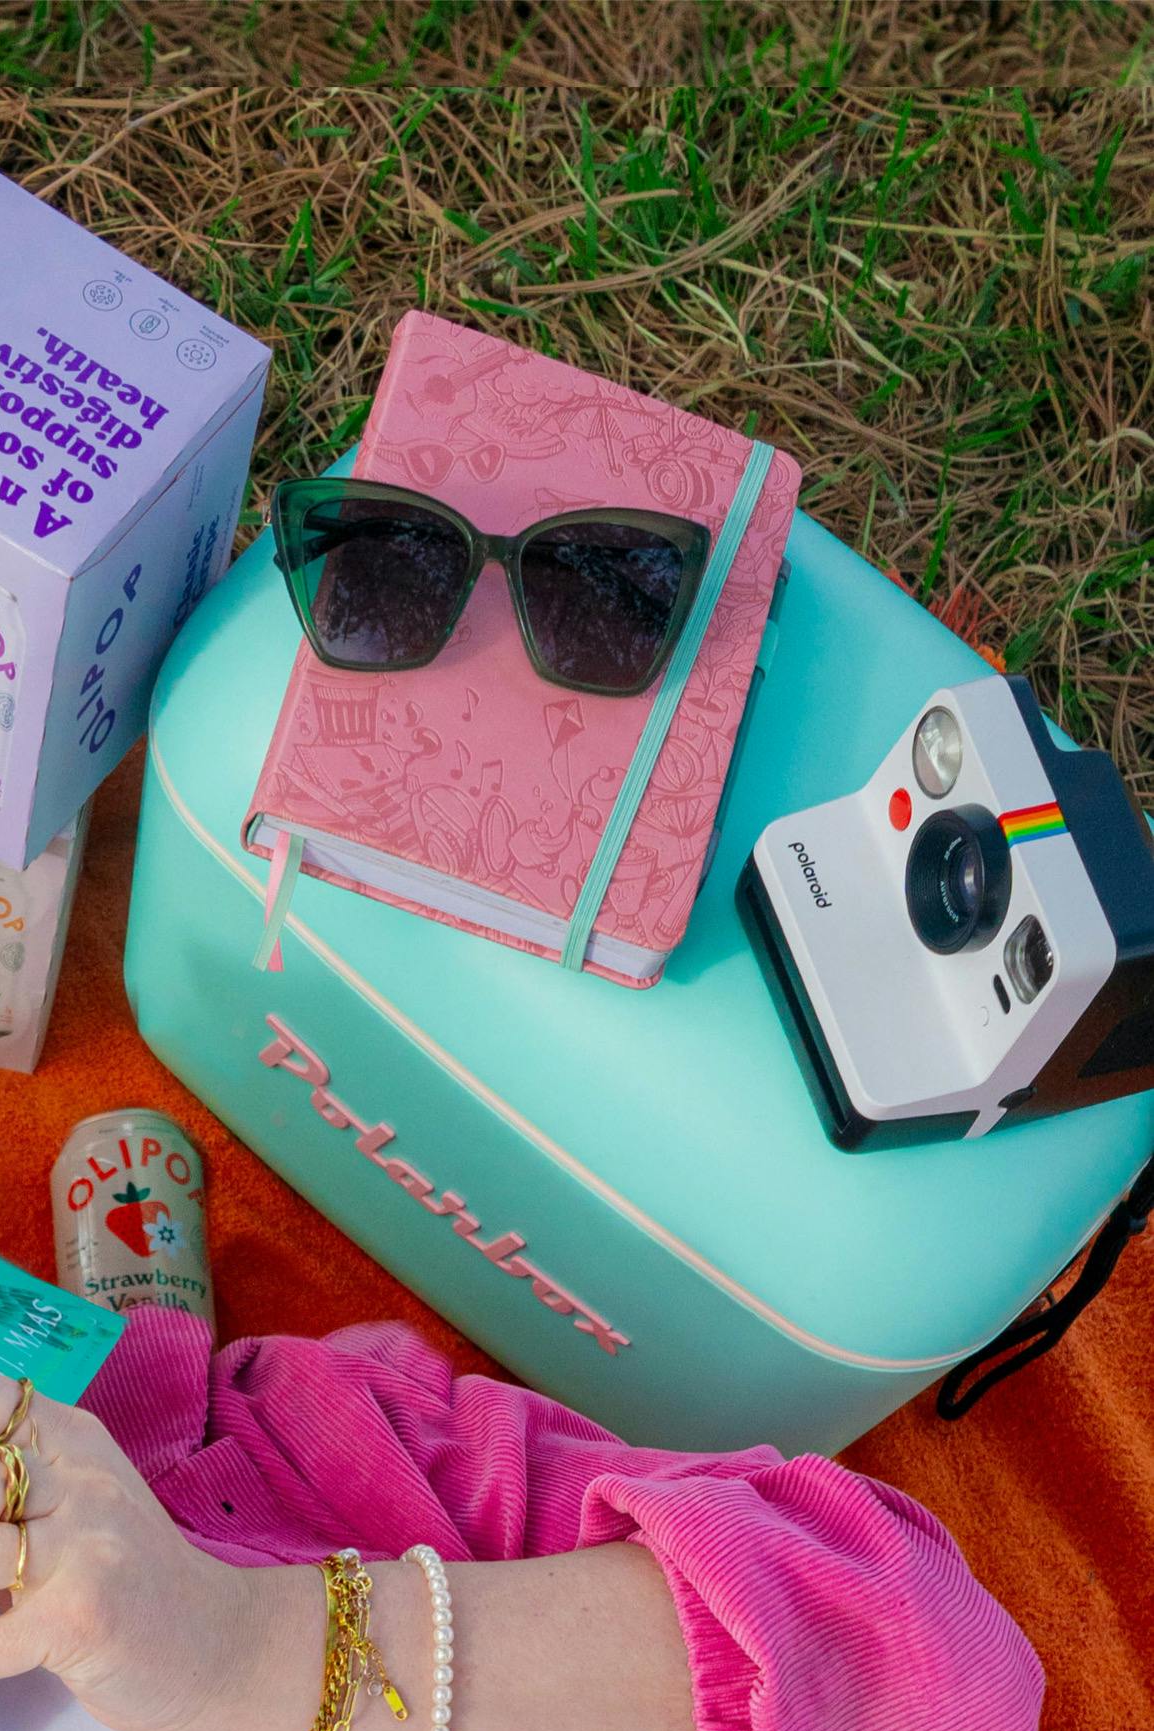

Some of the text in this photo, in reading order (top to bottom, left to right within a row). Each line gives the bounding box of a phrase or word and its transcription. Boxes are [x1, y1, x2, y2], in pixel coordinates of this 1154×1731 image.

[36, 326, 170, 431] health.
[41, 467, 95, 504] of
[32, 502, 73, 538] A
[76, 563, 144, 754] OLIPOP
[787, 841, 833, 909] polaroid
[85, 1268, 206, 1299] Strawberry
[3, 1298, 63, 1358] MAAS
